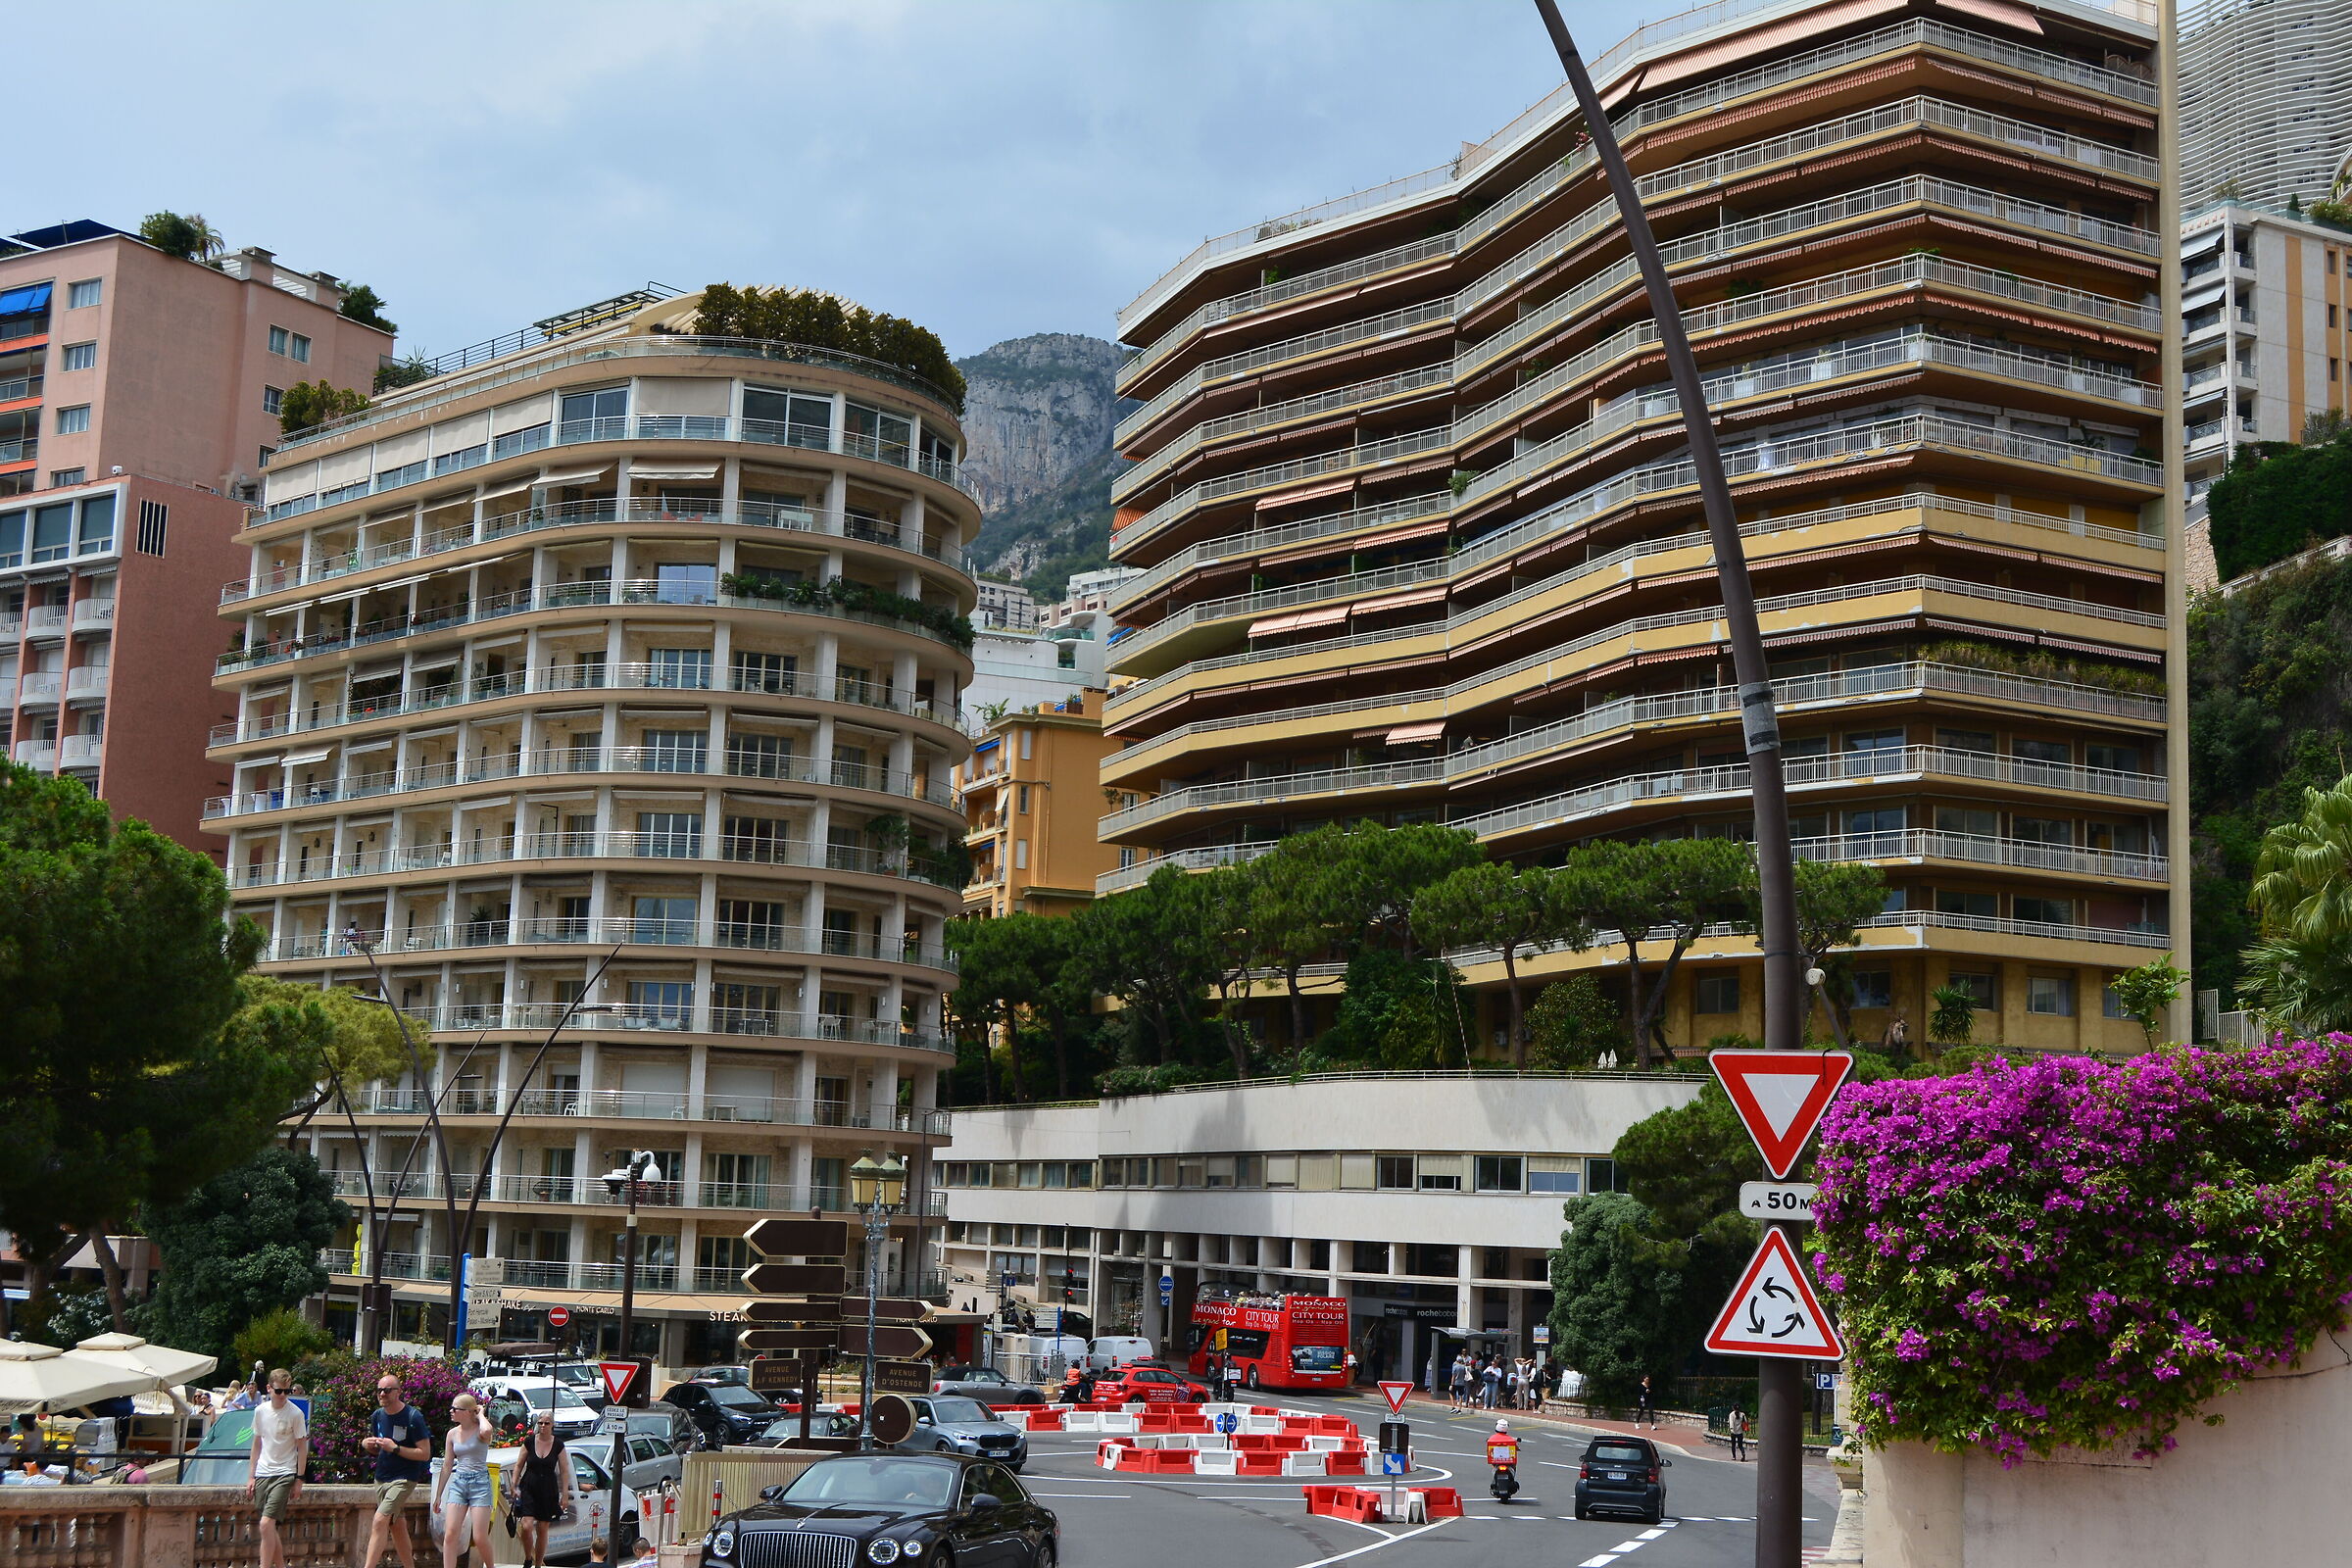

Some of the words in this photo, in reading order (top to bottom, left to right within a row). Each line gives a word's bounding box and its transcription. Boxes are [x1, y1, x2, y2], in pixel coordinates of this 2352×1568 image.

[1768, 1192, 1797, 1210] 50
[1195, 1304, 1237, 1316] MONACO
[1246, 1310, 1260, 1322] CITY
[1260, 1311, 1280, 1324] TOUR
[889, 1368, 918, 1377] AVENUE
[768, 1375, 799, 1384] KENNEDY
[881, 1378, 923, 1388] D'OSTENDE
[1820, 1374, 1831, 1388] P
